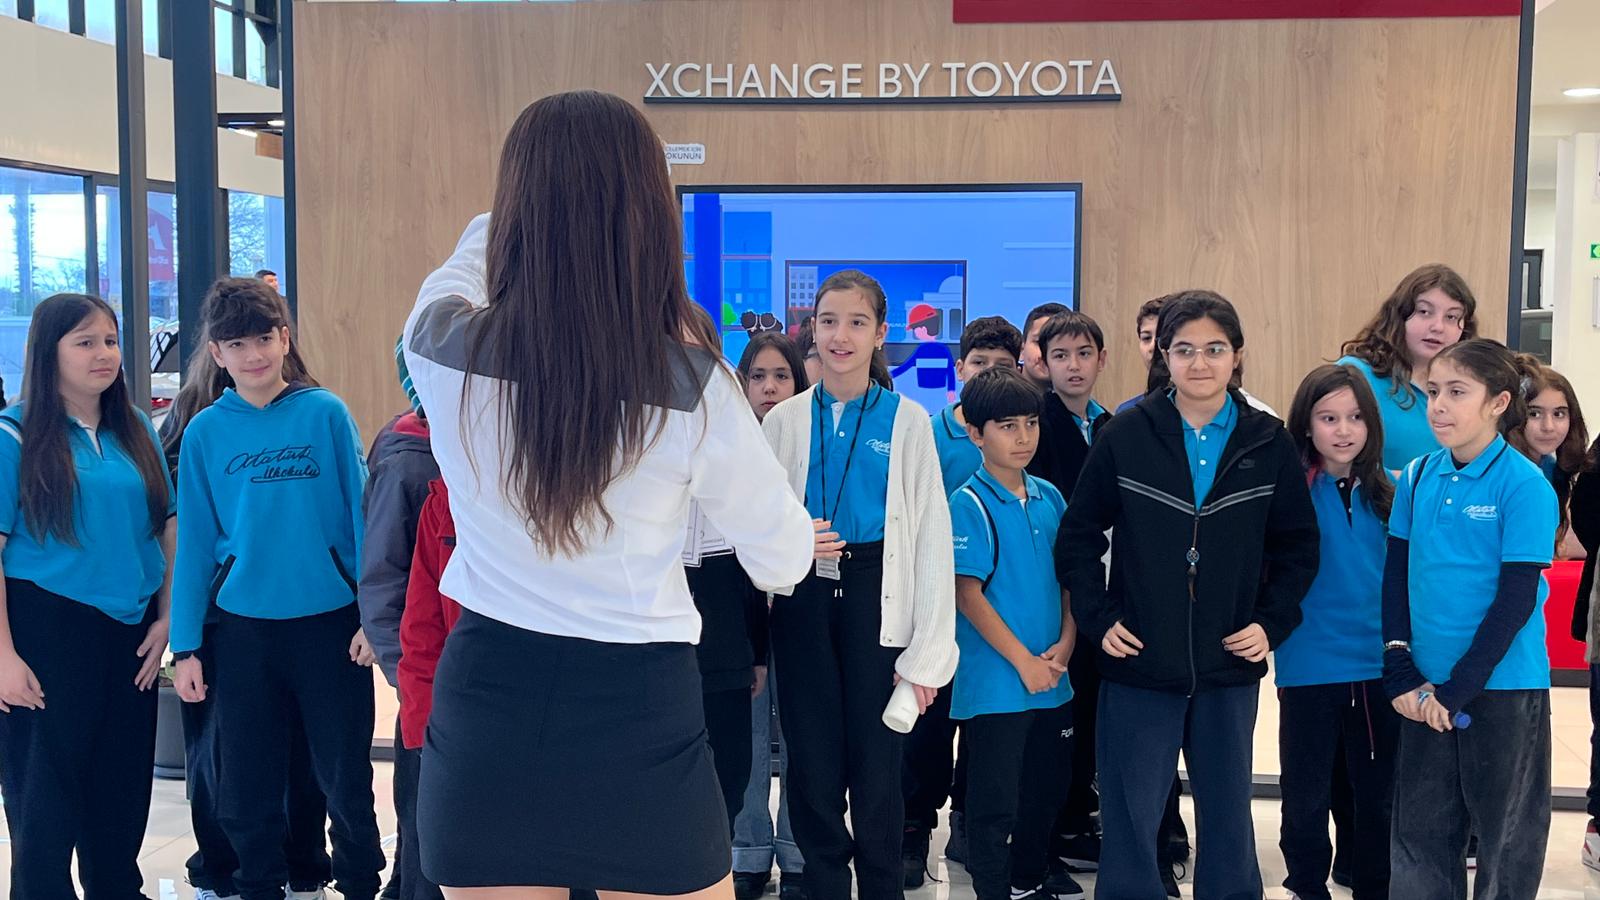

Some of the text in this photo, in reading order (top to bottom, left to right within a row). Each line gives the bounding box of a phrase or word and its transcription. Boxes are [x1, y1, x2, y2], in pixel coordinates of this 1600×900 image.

[645, 59, 1122, 98] XCHANGE BY TOYOTA
